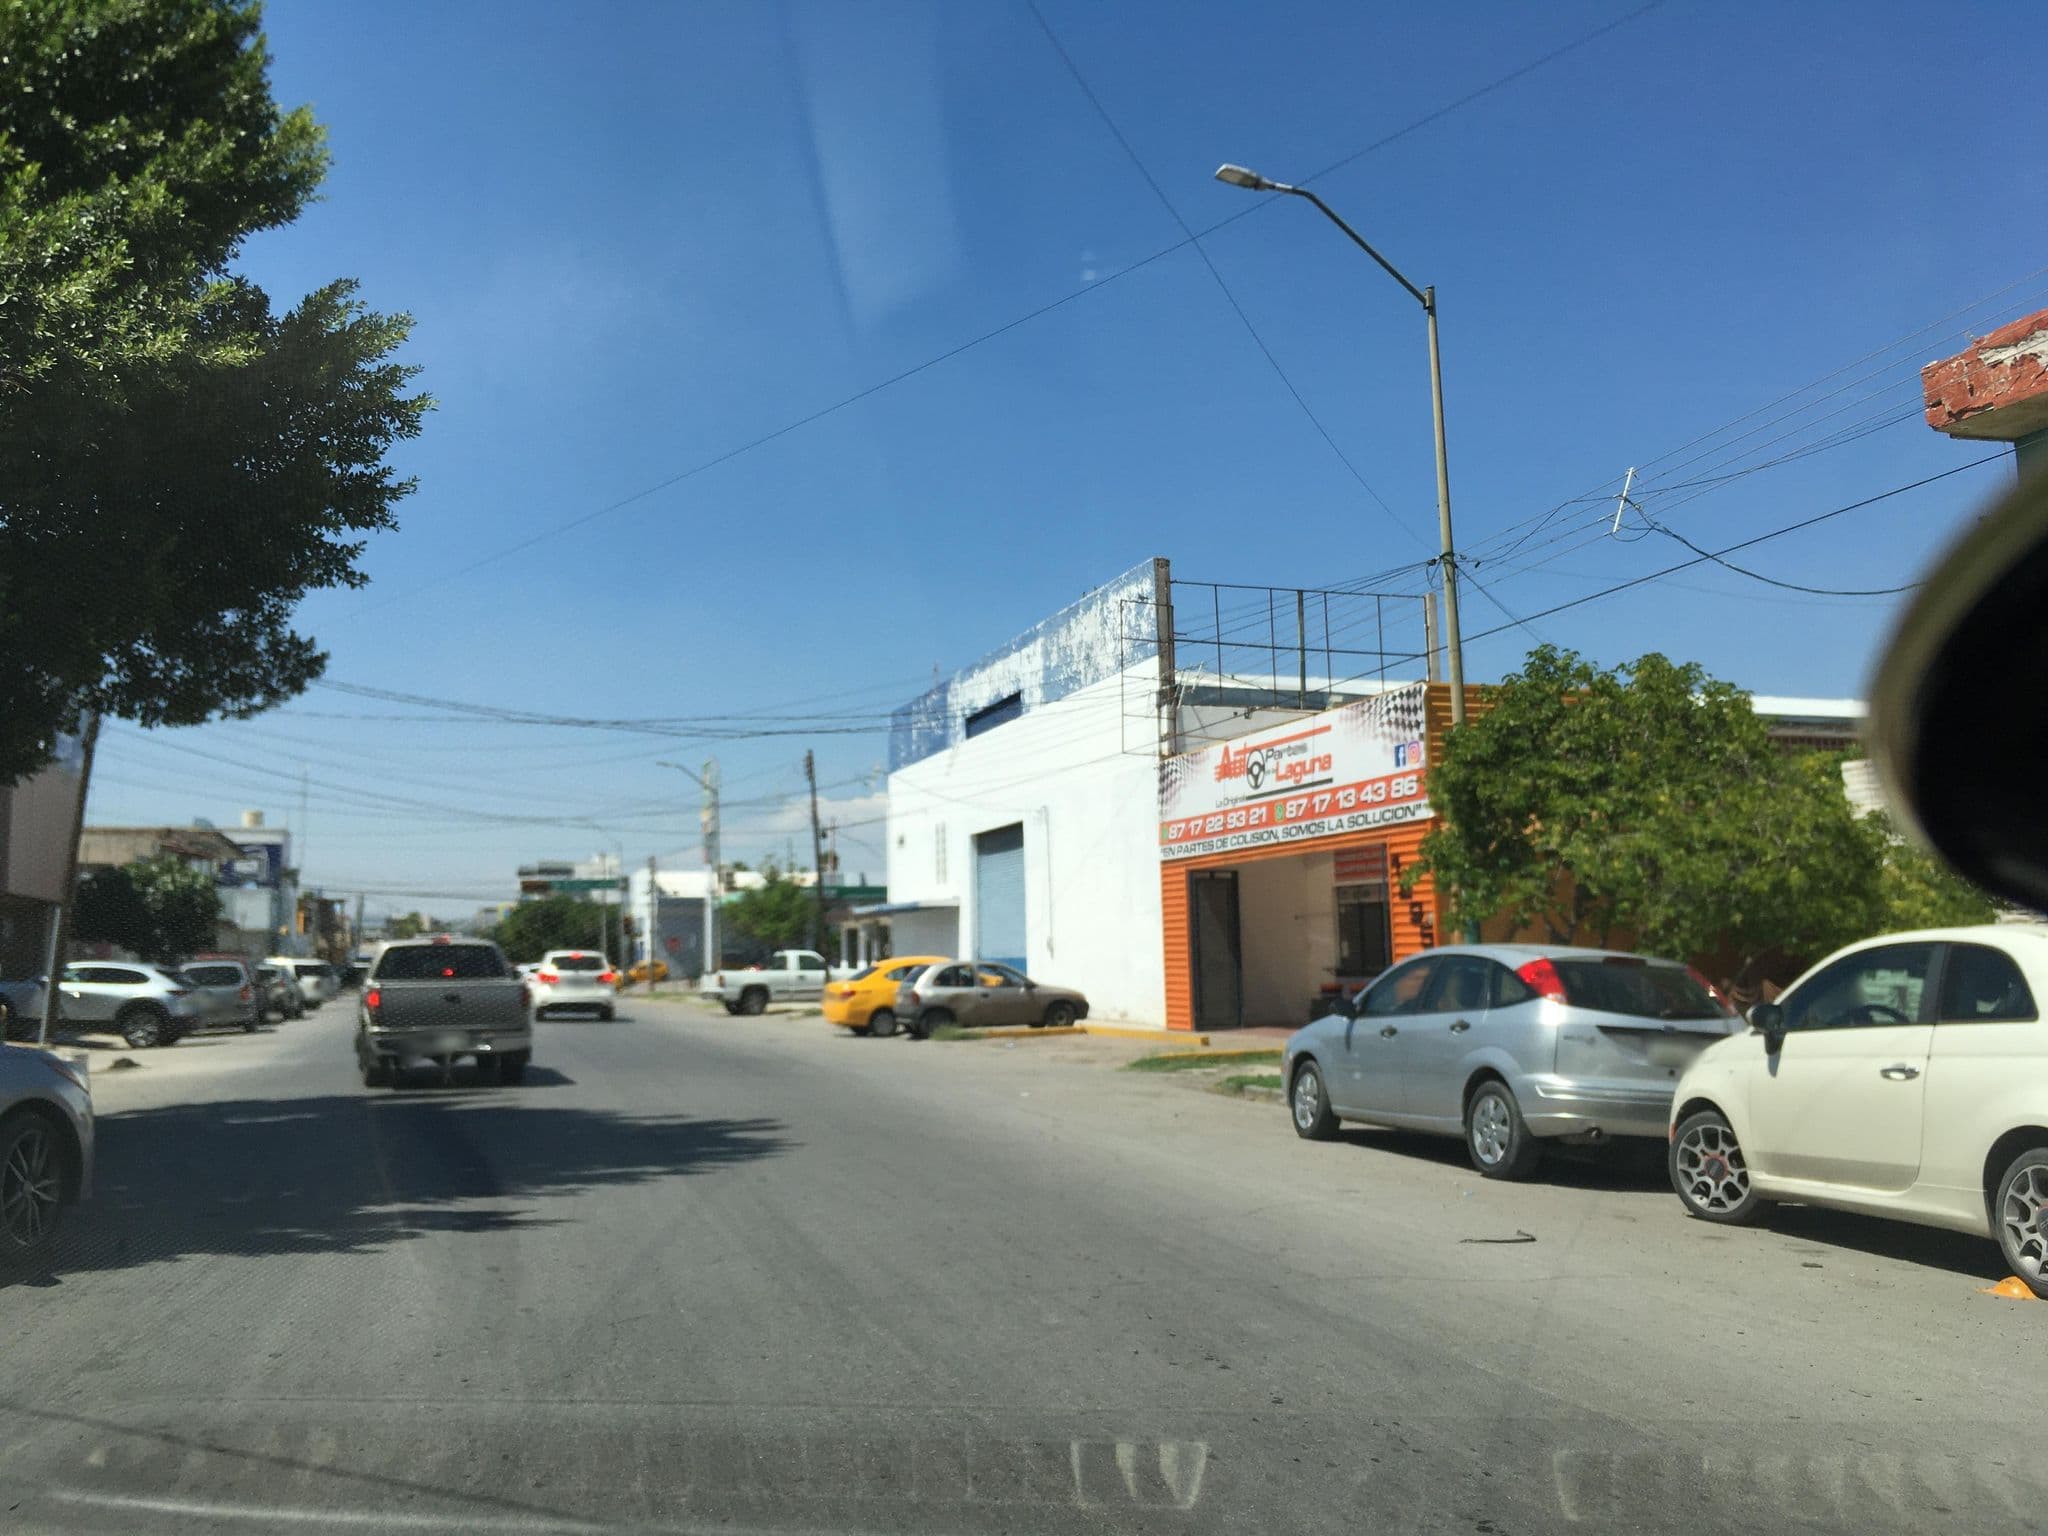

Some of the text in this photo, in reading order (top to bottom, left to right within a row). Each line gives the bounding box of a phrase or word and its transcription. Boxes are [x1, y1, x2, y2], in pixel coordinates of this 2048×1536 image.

[1275, 753, 1332, 784] Laguna
[1285, 775, 1418, 819] 87 17 13 43 86
[1168, 806, 1267, 839] 87 17 22 93 21
[1177, 841, 1214, 855] PARTES
[1216, 837, 1229, 850] DE
[1282, 821, 1325, 839] SOMOS
[1327, 818, 1344, 832] LA
